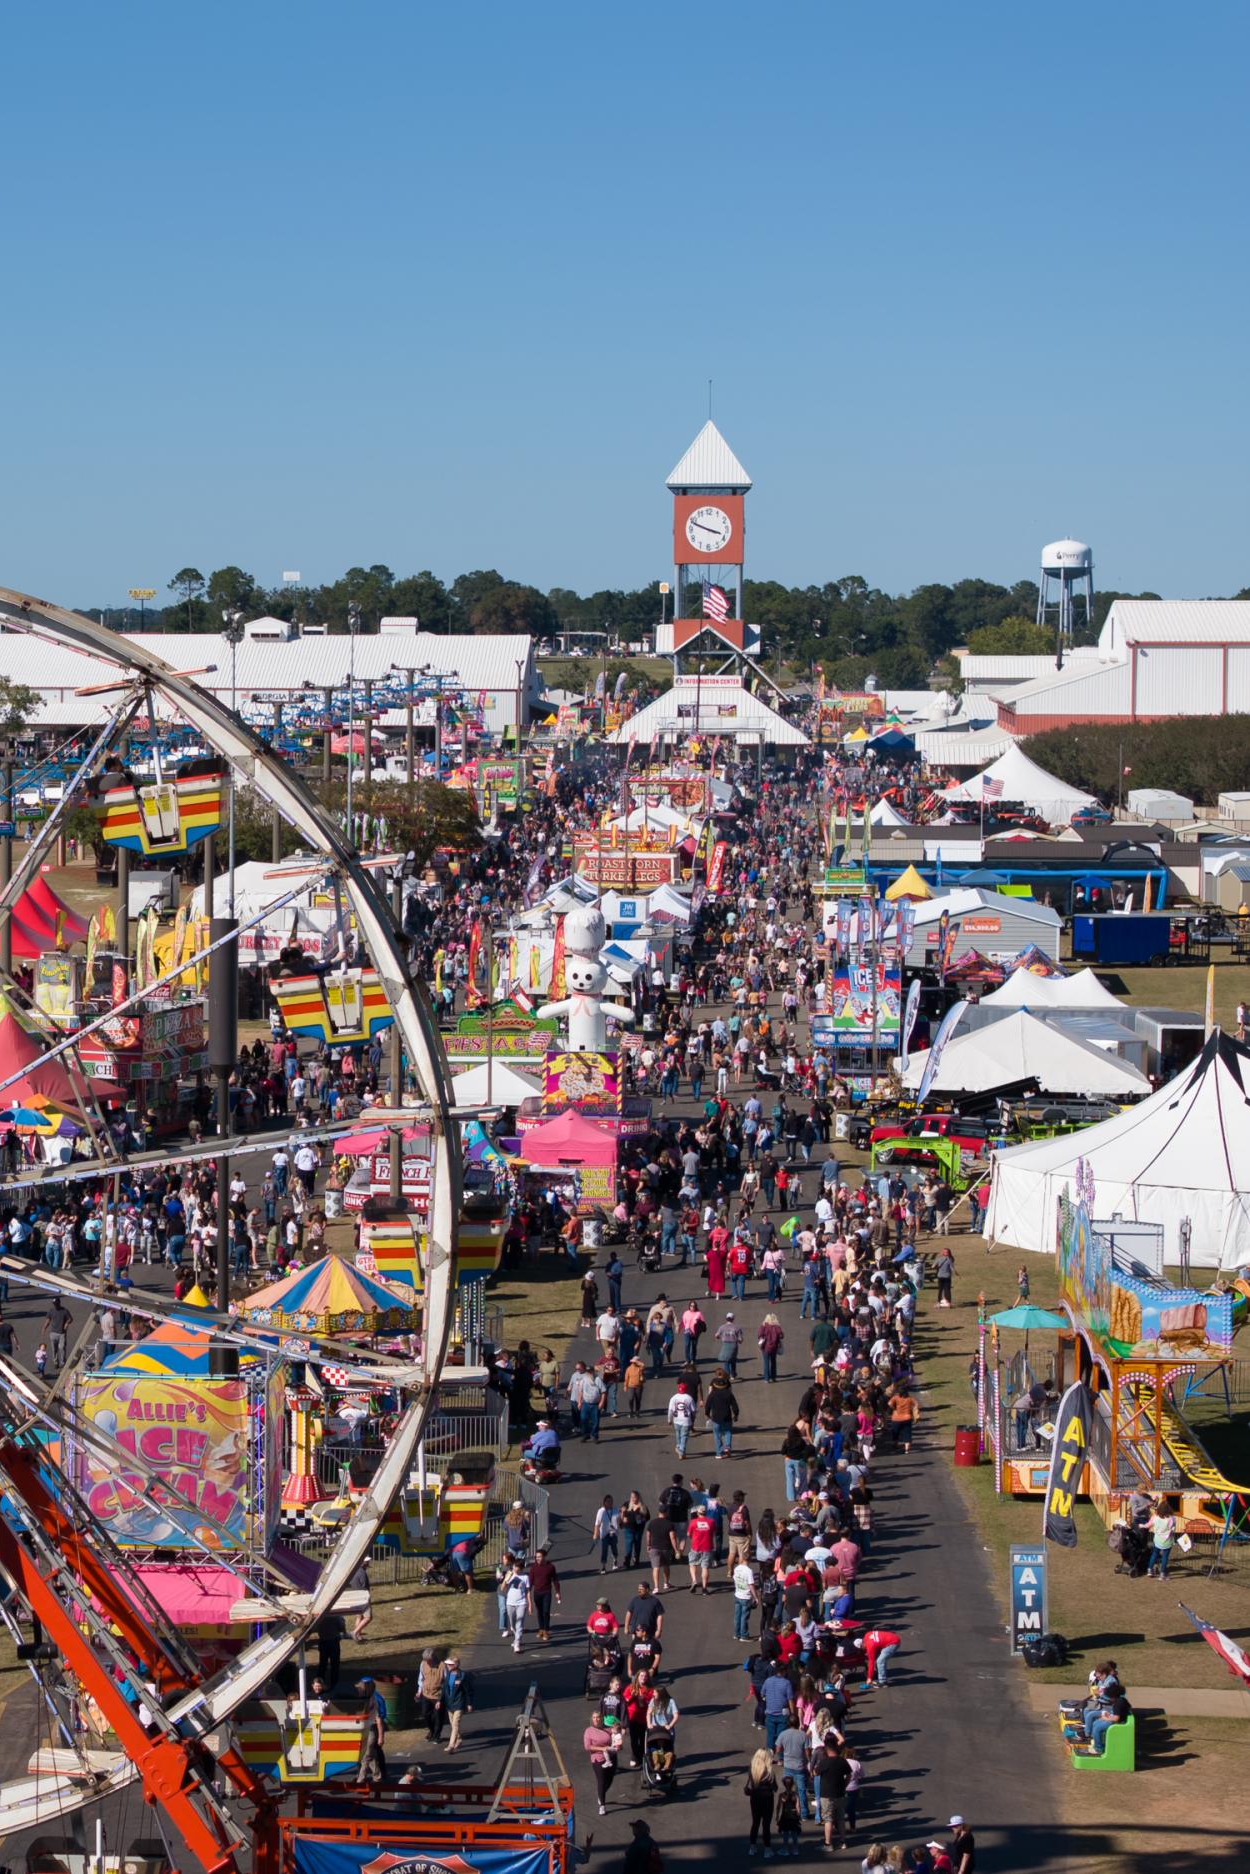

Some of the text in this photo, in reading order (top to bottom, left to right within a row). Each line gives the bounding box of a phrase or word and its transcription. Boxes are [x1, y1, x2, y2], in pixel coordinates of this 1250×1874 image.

[1062, 552, 1079, 560] Perry
[697, 827, 709, 859] ATM
[588, 860, 660, 869] ROAST CORN
[587, 870, 661, 881] TURKEY LEGS
[126, 1398, 207, 1422] ALLIE'S
[114, 1424, 210, 1468] ICE
[1019, 1554, 1039, 1562] ATM
[1017, 1567, 1041, 1630] ATM
[415, 1863, 428, 1873] OF
